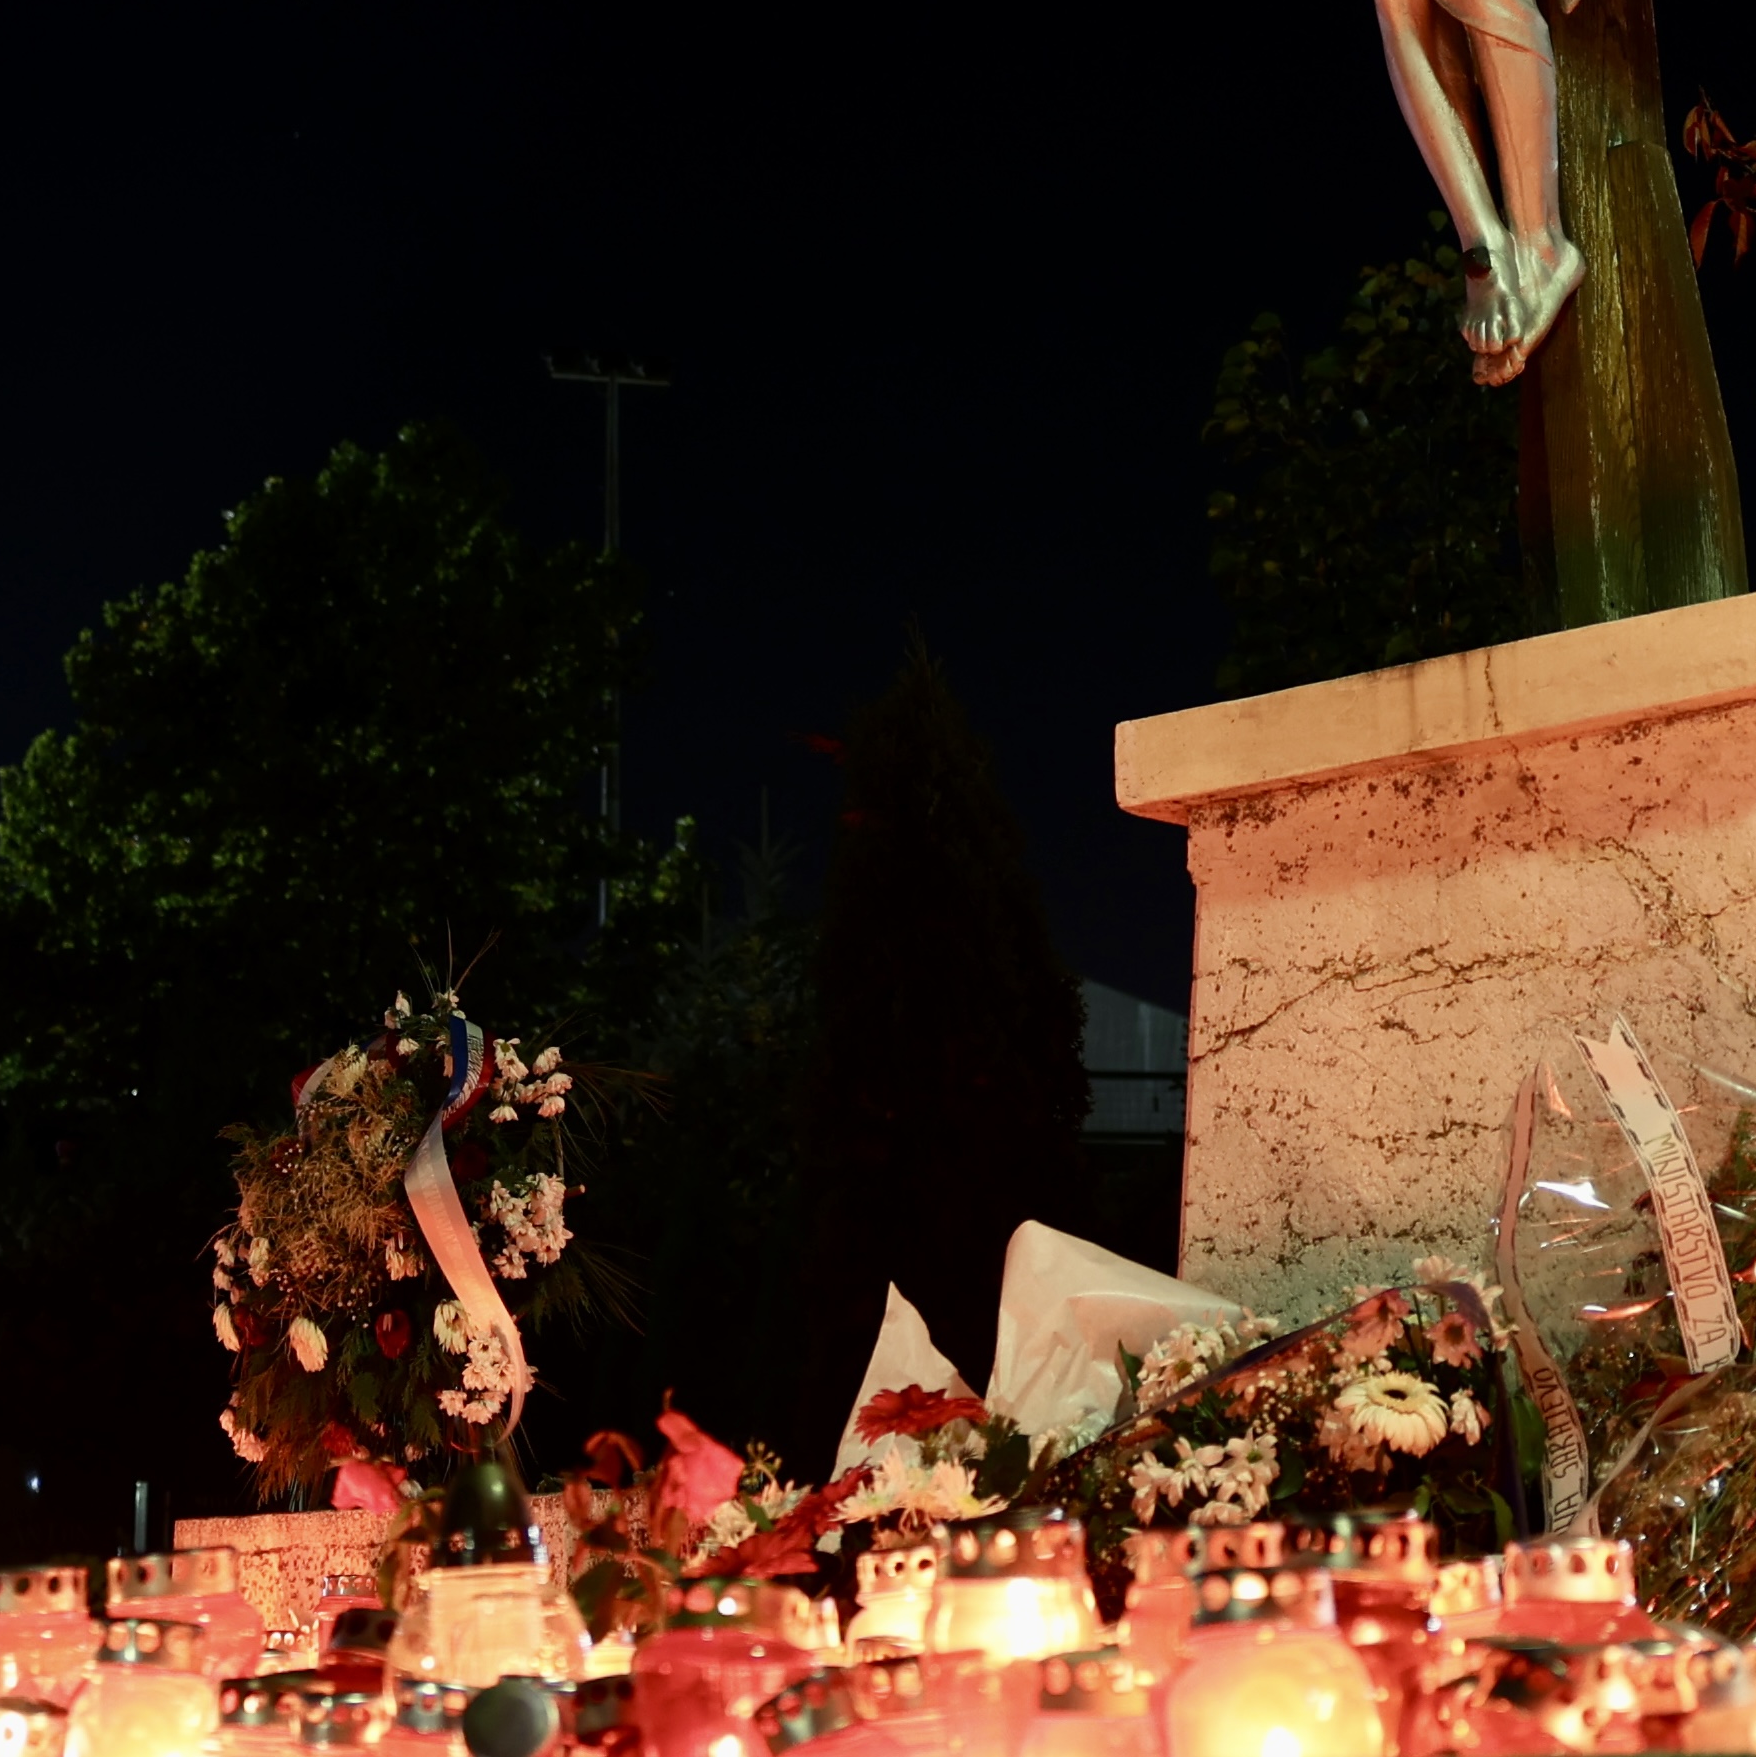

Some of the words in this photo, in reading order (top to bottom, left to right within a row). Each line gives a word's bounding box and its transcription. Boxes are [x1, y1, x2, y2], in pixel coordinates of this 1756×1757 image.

[1644, 1131, 1718, 1300] MINISTARSTVO
[1692, 1313, 1727, 1347] ZA
[1533, 1367, 1579, 1480] SARAJEVO
